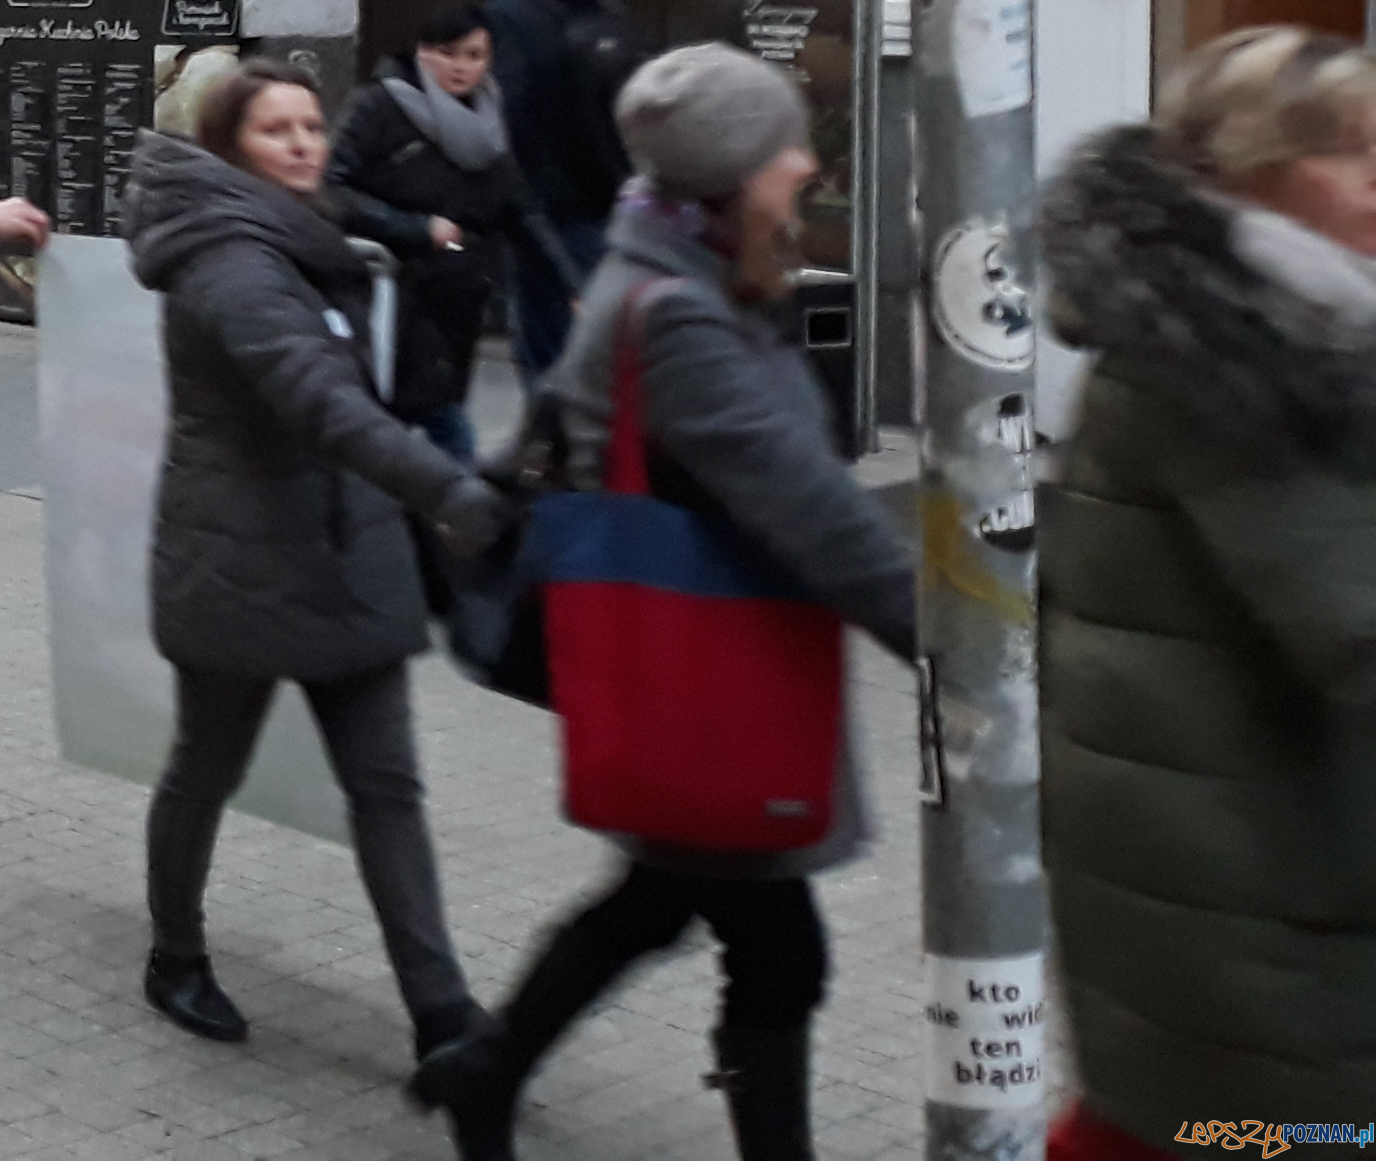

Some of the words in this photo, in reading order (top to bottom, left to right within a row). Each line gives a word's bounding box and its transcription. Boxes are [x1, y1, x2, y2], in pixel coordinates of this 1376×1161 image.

[968, 978, 1021, 1003] kto
[927, 1002, 960, 1029] nie
[970, 1038, 1021, 1058] ten
